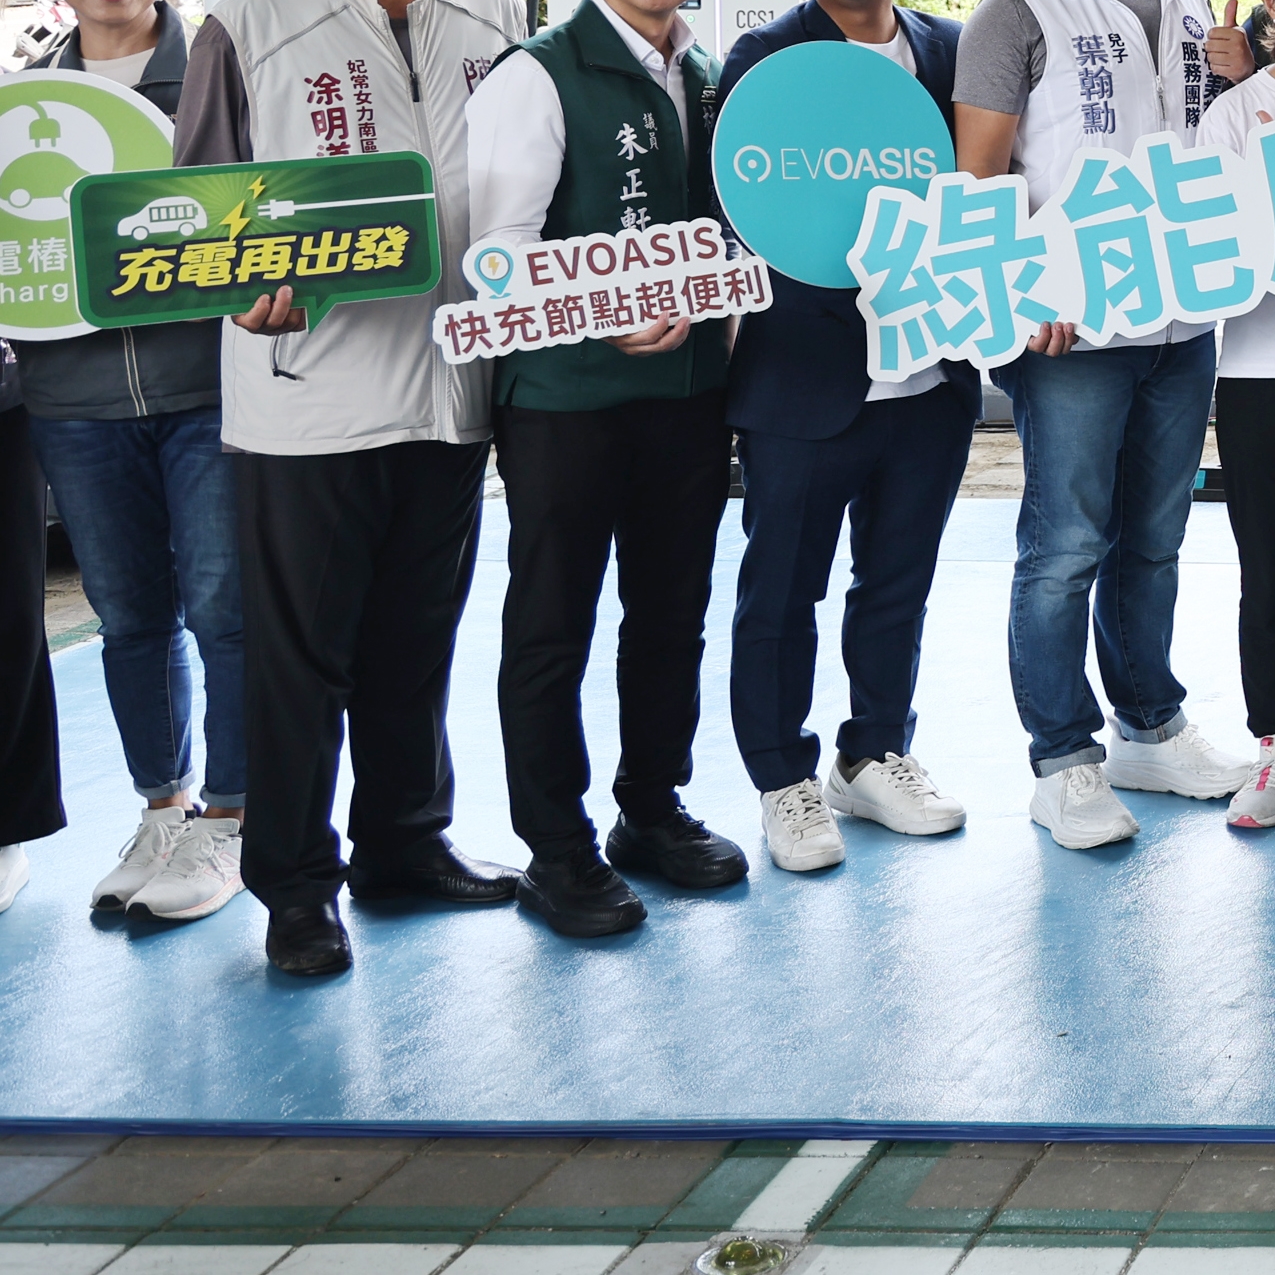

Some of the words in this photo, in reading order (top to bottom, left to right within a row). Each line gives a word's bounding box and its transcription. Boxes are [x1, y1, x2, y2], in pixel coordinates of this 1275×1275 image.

[736, 9, 774, 29] CCS1
[1107, 33, 1128, 64] 兒子
[1181, 41, 1202, 129] 服務團隊
[643, 112, 659, 150] 議員
[615, 123, 651, 233] 朱正軒
[782, 147, 938, 180] EVOASIS
[111, 225, 410, 296] 充電再出發
[526, 226, 719, 287] EVOASIS
[444, 264, 766, 357] 快充節點超便利
